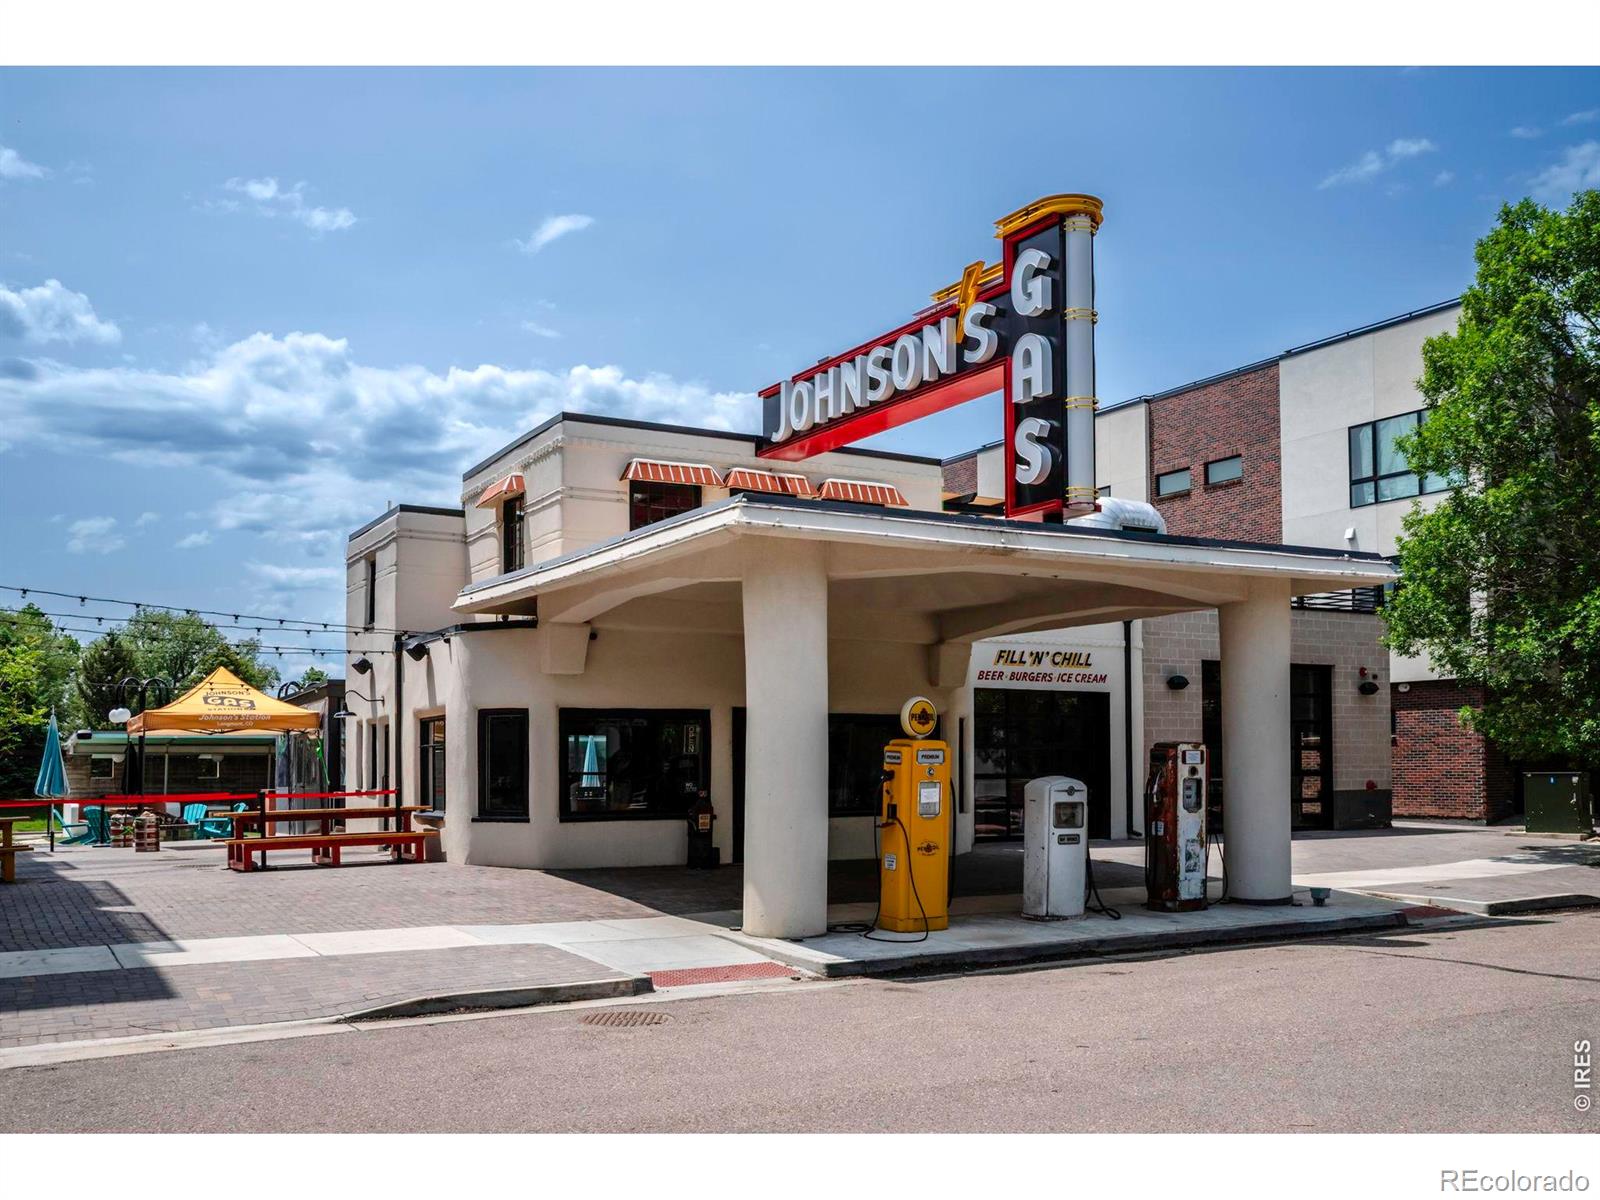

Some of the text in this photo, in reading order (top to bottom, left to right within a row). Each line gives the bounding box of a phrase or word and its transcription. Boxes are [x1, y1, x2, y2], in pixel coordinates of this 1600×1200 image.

[771, 301, 998, 443] JOHNSON'S
[1010, 248, 1053, 485] GAS
[993, 649, 1027, 667] FILL
[1050, 651, 1093, 669] CHILL
[977, 670, 1108, 684] BEER BURGERS ICE CREAM
[207, 696, 252, 707] GAS
